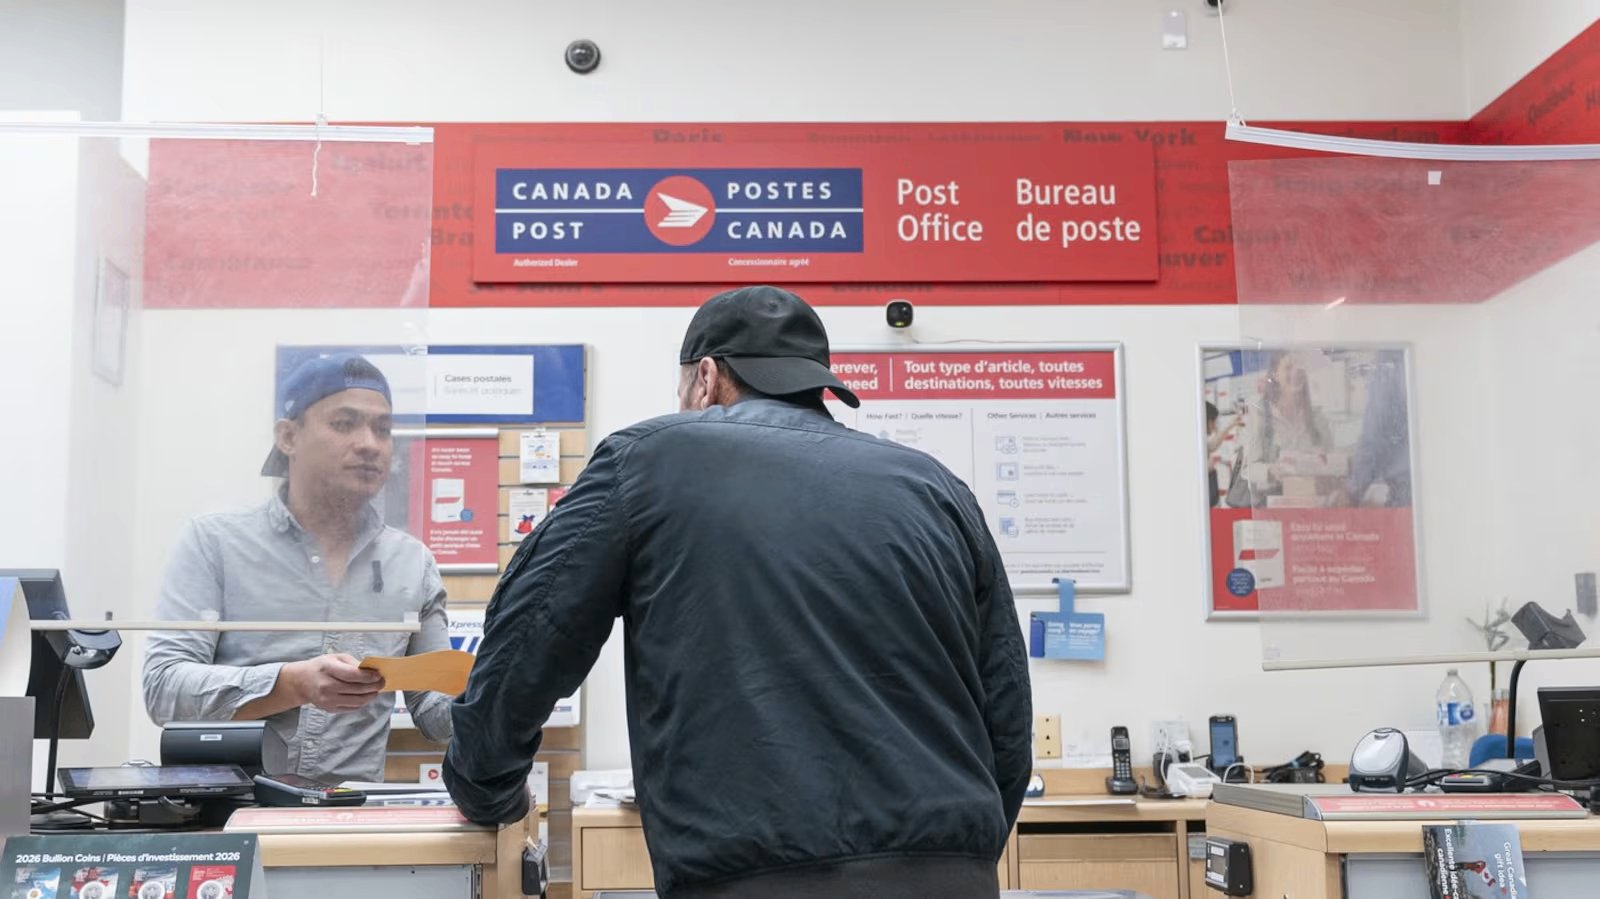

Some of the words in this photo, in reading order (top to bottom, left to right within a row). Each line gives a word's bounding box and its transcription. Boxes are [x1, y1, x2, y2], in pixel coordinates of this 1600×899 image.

[653, 127, 723, 143] Paris
[1133, 128, 1197, 146] York
[512, 182, 633, 200] CANADA
[727, 182, 832, 200] POSTES
[897, 178, 960, 206] Post
[1016, 178, 1117, 206] Bureau
[512, 221, 584, 240] POST
[727, 221, 848, 240] CANADA
[897, 213, 984, 243] Office
[1016, 213, 1051, 243] de
[1062, 216, 1142, 249] poste
[513, 258, 553, 267] Authorized
[555, 258, 579, 267] Dealer
[728, 257, 787, 266] Concessionnaire
[789, 257, 810, 268] agréé
[830, 363, 878, 375] erever,
[904, 360, 936, 373] Tout
[939, 361, 972, 376] type
[1039, 361, 1085, 373] toutes
[444, 374, 471, 383] Cases
[473, 374, 512, 386] postales
[904, 377, 995, 391] destinations,
[999, 378, 1044, 390] toutes
[1047, 376, 1103, 390] vitesses
[987, 412, 1008, 420] Other
[1009, 412, 1037, 420] Services
[1045, 412, 1068, 420] Autres
[1069, 412, 1097, 420] services
[449, 620, 483, 630] Xpress
[15, 854, 41, 864] 2026
[42, 853, 74, 863] Bullion
[75, 853, 101, 863] Coins
[106, 851, 137, 863] Pièces
[137, 851, 214, 862] d'investissement
[214, 851, 241, 861] 2026
[1444, 828, 1456, 870] Excellente
[1503, 841, 1513, 865] Great
[1494, 853, 1505, 869] gift
[1437, 847, 1449, 895] canadienne
